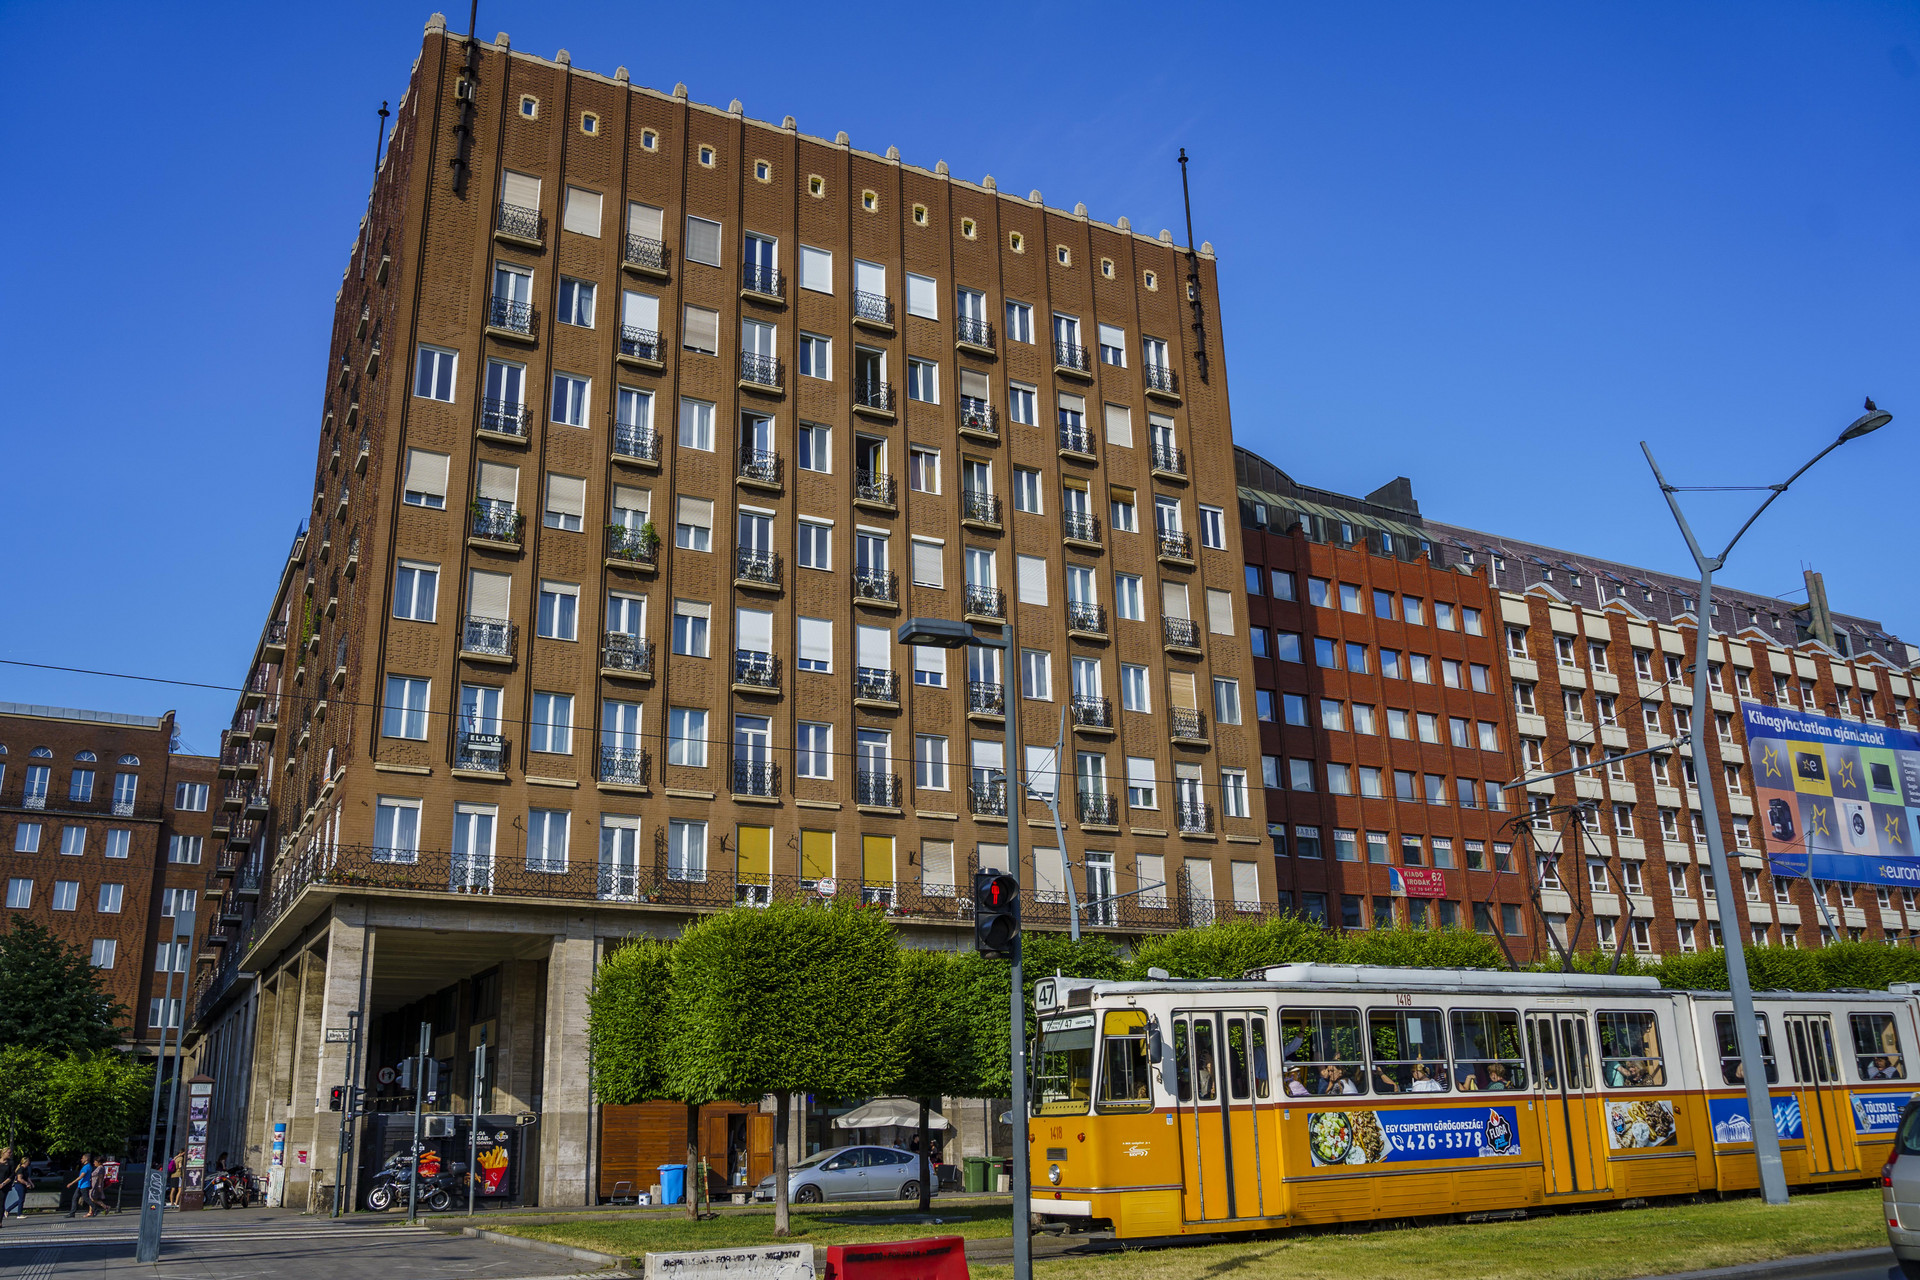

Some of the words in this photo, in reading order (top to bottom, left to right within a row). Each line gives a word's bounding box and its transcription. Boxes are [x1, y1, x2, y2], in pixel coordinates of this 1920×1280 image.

[1748, 709, 1832, 737] Kihagyhatatlan
[1834, 726, 1885, 745] ajánlatok!
[470, 735, 500, 743] ELADÓ
[1407, 878, 1430, 886] IRODÁK
[1039, 984, 1054, 1005] 47
[1396, 993, 1411, 1006] 1418
[1065, 1019, 1072, 1028] 47
[1864, 1101, 1887, 1113] TÖLTSD
[1887, 1103, 1897, 1113] LE
[1867, 1114, 1876, 1124] AZ
[1877, 1113, 1899, 1124] APPOT!
[1385, 1124, 1398, 1133] EGY
[1400, 1122, 1433, 1133] CSIPETNYI
[1434, 1119, 1484, 1131] GÖRÖGORSZÁG!
[1489, 1124, 1508, 1140] FLOGA
[1050, 1126, 1063, 1140] 1418
[1407, 1132, 1482, 1151] 426-5378
